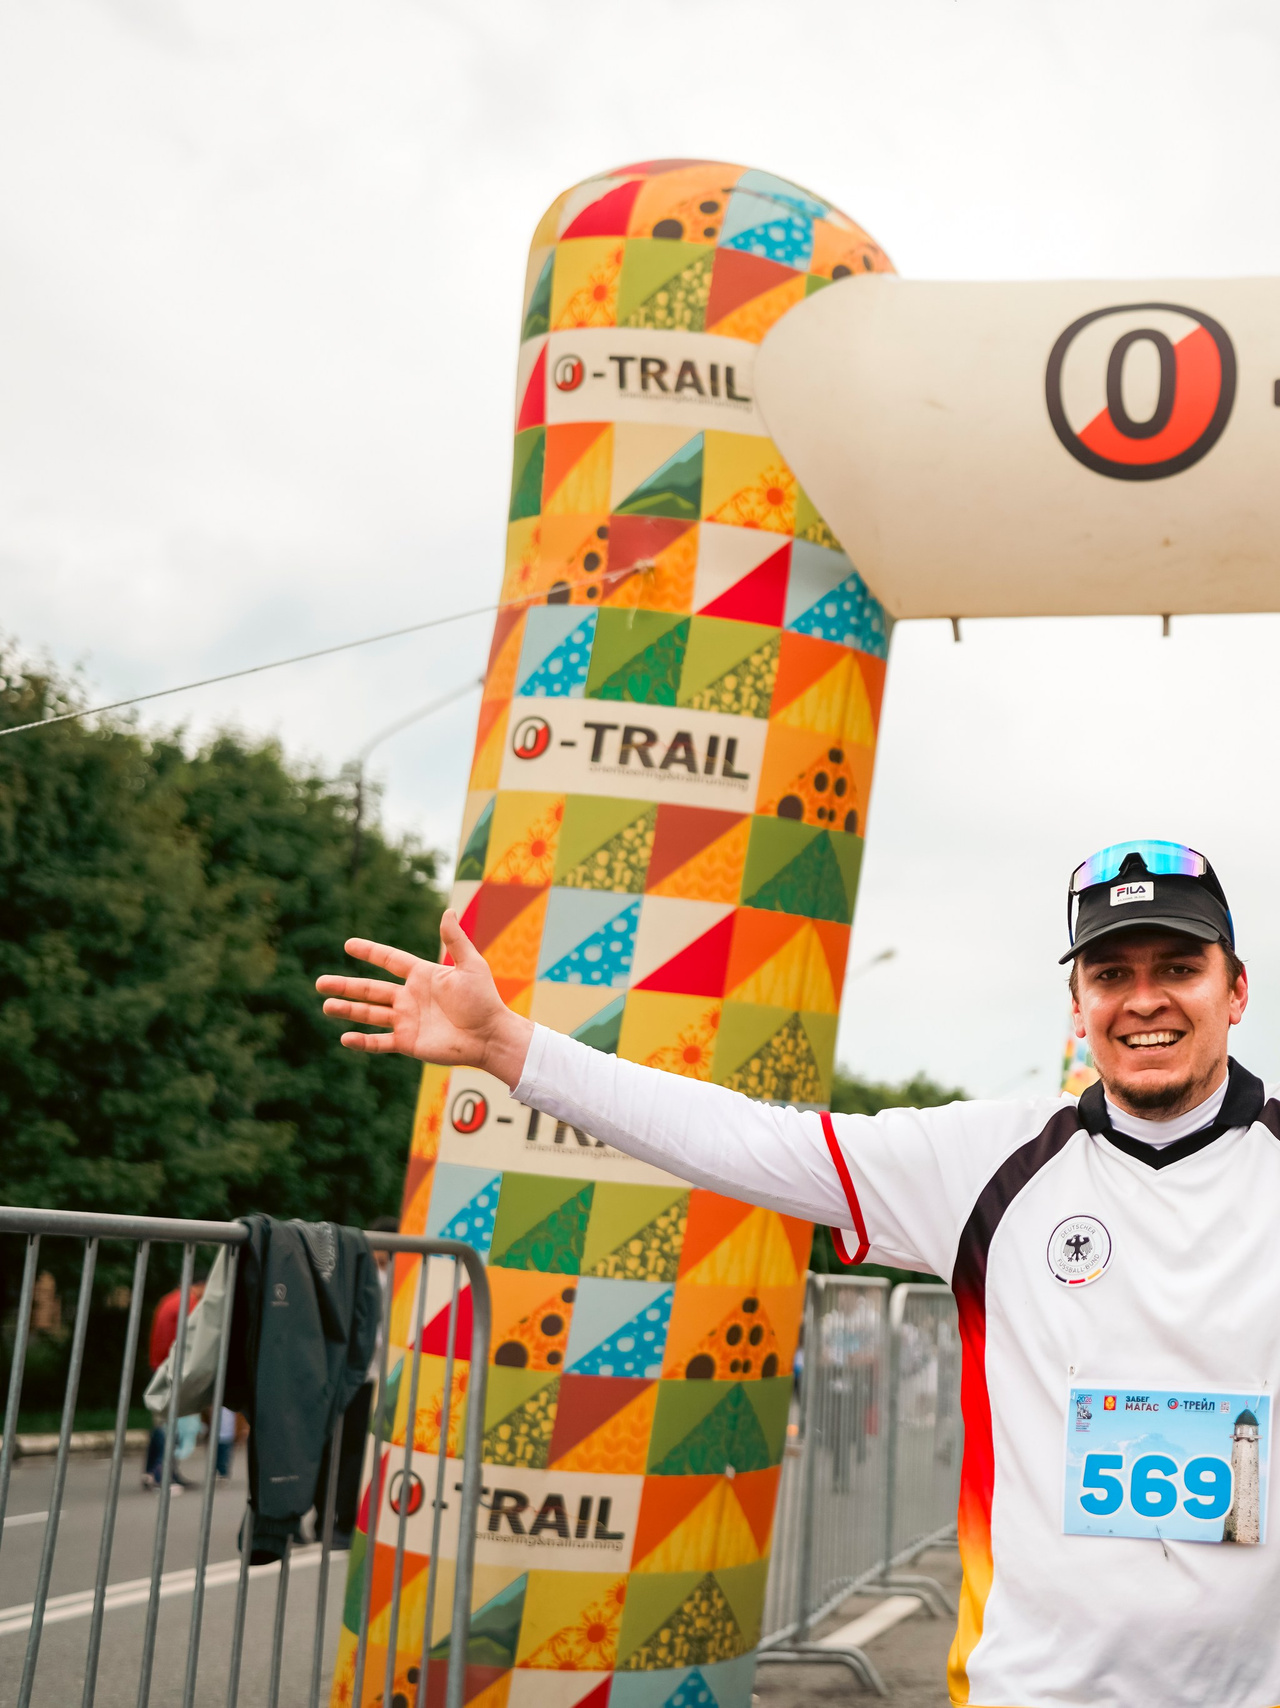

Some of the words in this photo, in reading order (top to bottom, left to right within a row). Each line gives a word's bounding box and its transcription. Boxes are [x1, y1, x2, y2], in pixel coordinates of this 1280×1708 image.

[1117, 885, 1146, 898] FILA
[1061, 1224, 1096, 1239] DEUTSCHER
[1058, 1254, 1099, 1273] FUSSBALL-BUND
[1125, 1403, 1159, 1411] МАГАС
[1080, 1454, 1232, 1520] 569
